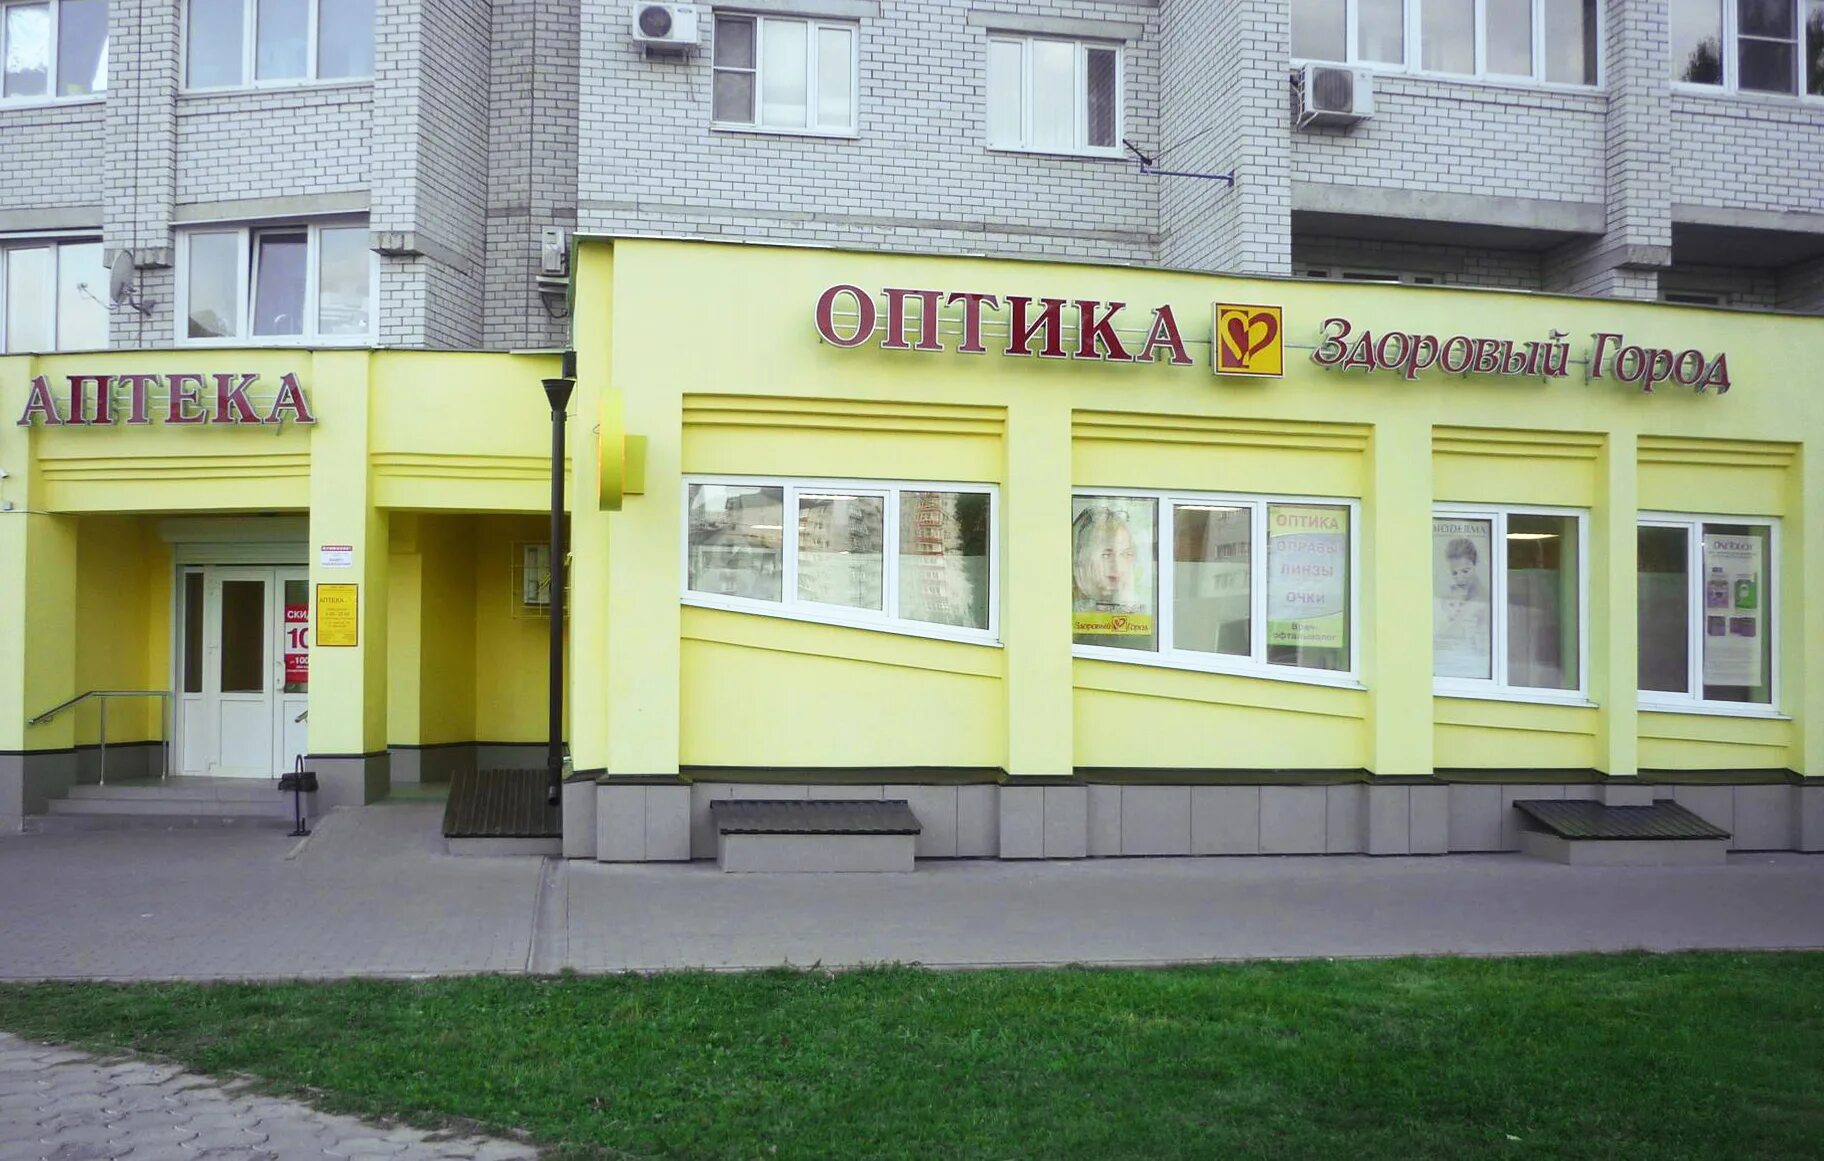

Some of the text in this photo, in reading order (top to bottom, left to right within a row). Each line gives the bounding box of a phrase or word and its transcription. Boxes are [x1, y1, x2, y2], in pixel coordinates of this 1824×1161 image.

[814, 284, 1193, 366] ОПТИКА
[1309, 317, 1732, 395] Здоровый Город
[16, 372, 317, 426] АПТЕКА
[1277, 514, 1339, 530] ОПТИКА
[1281, 563, 1333, 577] ЛИНЗЫ
[1286, 591, 1325, 605] ОЧКИ
[287, 610, 309, 620] СКИ
